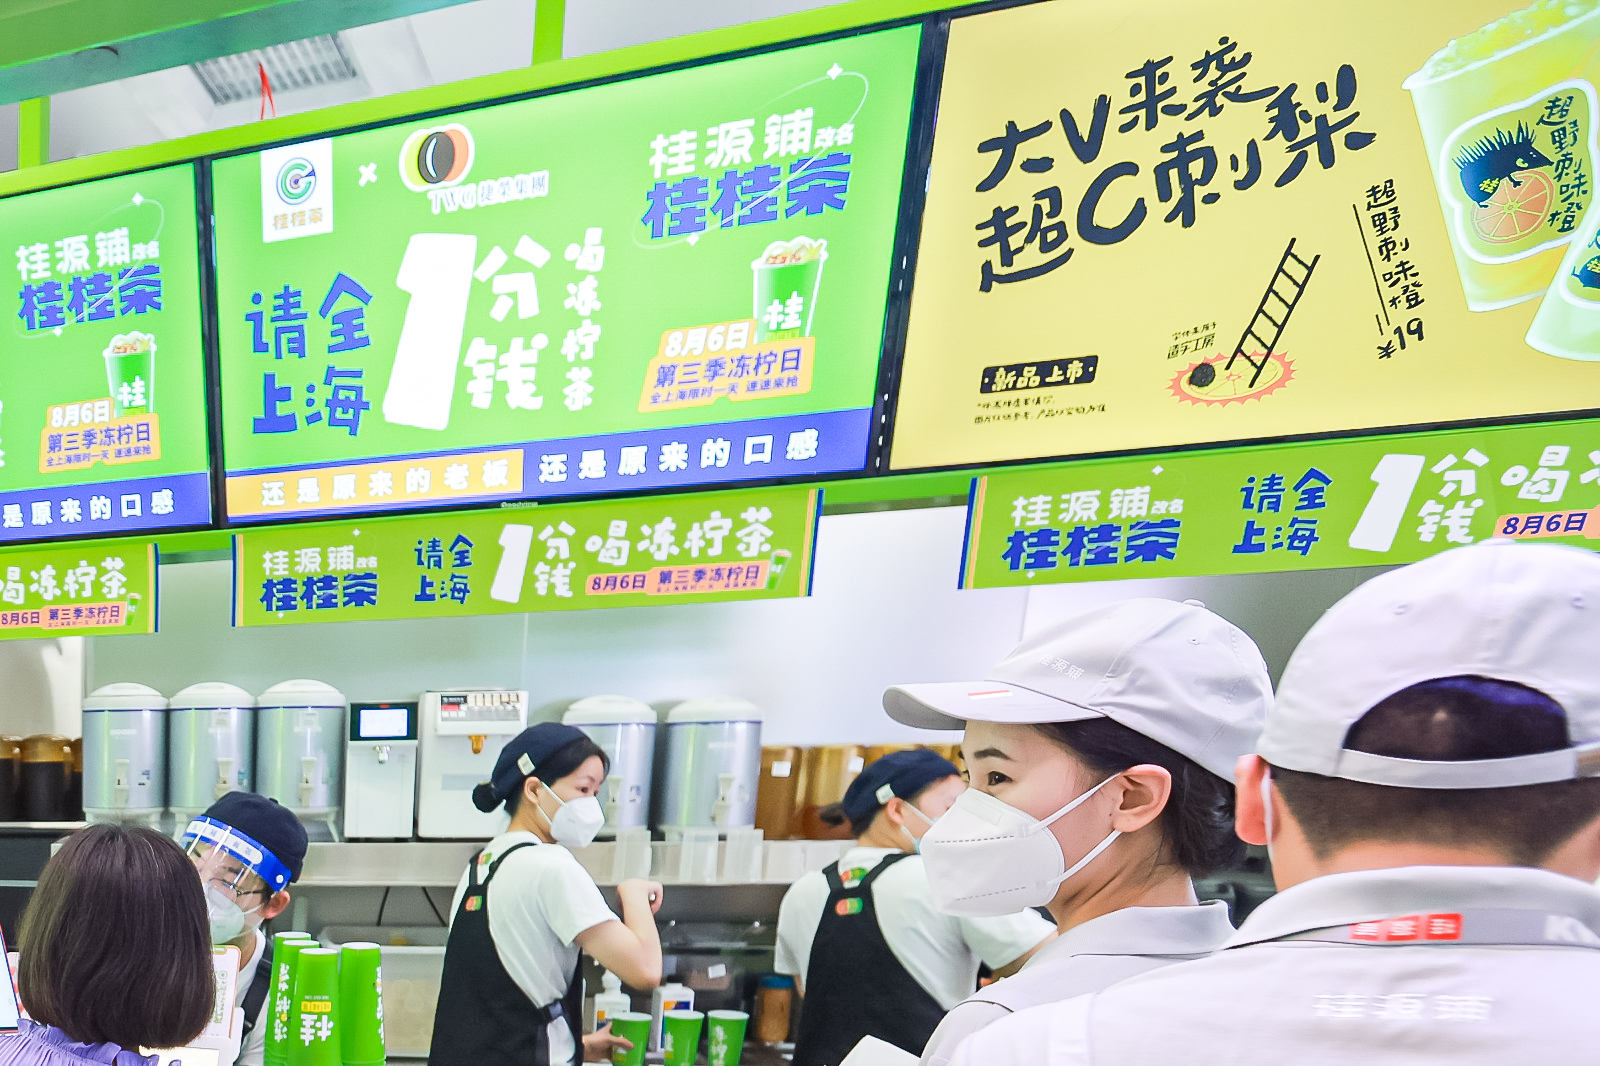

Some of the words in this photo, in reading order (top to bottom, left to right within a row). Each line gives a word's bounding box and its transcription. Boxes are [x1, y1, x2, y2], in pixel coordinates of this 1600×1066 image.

[976, 37, 1278, 192] 大V来袭
[976, 63, 1376, 293] 超C刺梨
[1536, 95, 1589, 233] 超野刺味橙
[641, 152, 852, 239] 桂桂茶
[1366, 179, 1425, 310] 超野刺味橙
[18, 263, 163, 331] 桂桂茶
[245, 271, 373, 360] 请全
[763, 290, 804, 330] 桂
[561, 227, 605, 410] 喝冻柠茶
[664, 321, 750, 358] 8月6日
[654, 348, 802, 388] 第三季冻柠日
[117, 375, 146, 407] 桂
[252, 367, 371, 436] 上海
[51, 400, 110, 428] 8月6日
[47, 422, 150, 453] 第三季冻柠日
[261, 457, 511, 506] 还是原来的老板
[539, 427, 820, 484] 还是原来的口感
[1240, 467, 1333, 513] 请全
[585, 506, 774, 566] 喝冻柠茶
[1232, 516, 1320, 558] 上海
[1502, 512, 1588, 535] 8月6日
[414, 533, 474, 569] 请全
[1002, 517, 1182, 573] 桂桂茶
[260, 572, 378, 611] 桂桂茶
[414, 573, 471, 604] 上海
[591, 574, 646, 591] 8月6日
[658, 564, 761, 585] 第三季冻柠日
[1, 611, 40, 625] 8月6日
[49, 604, 120, 621] 第三季冻柠日
